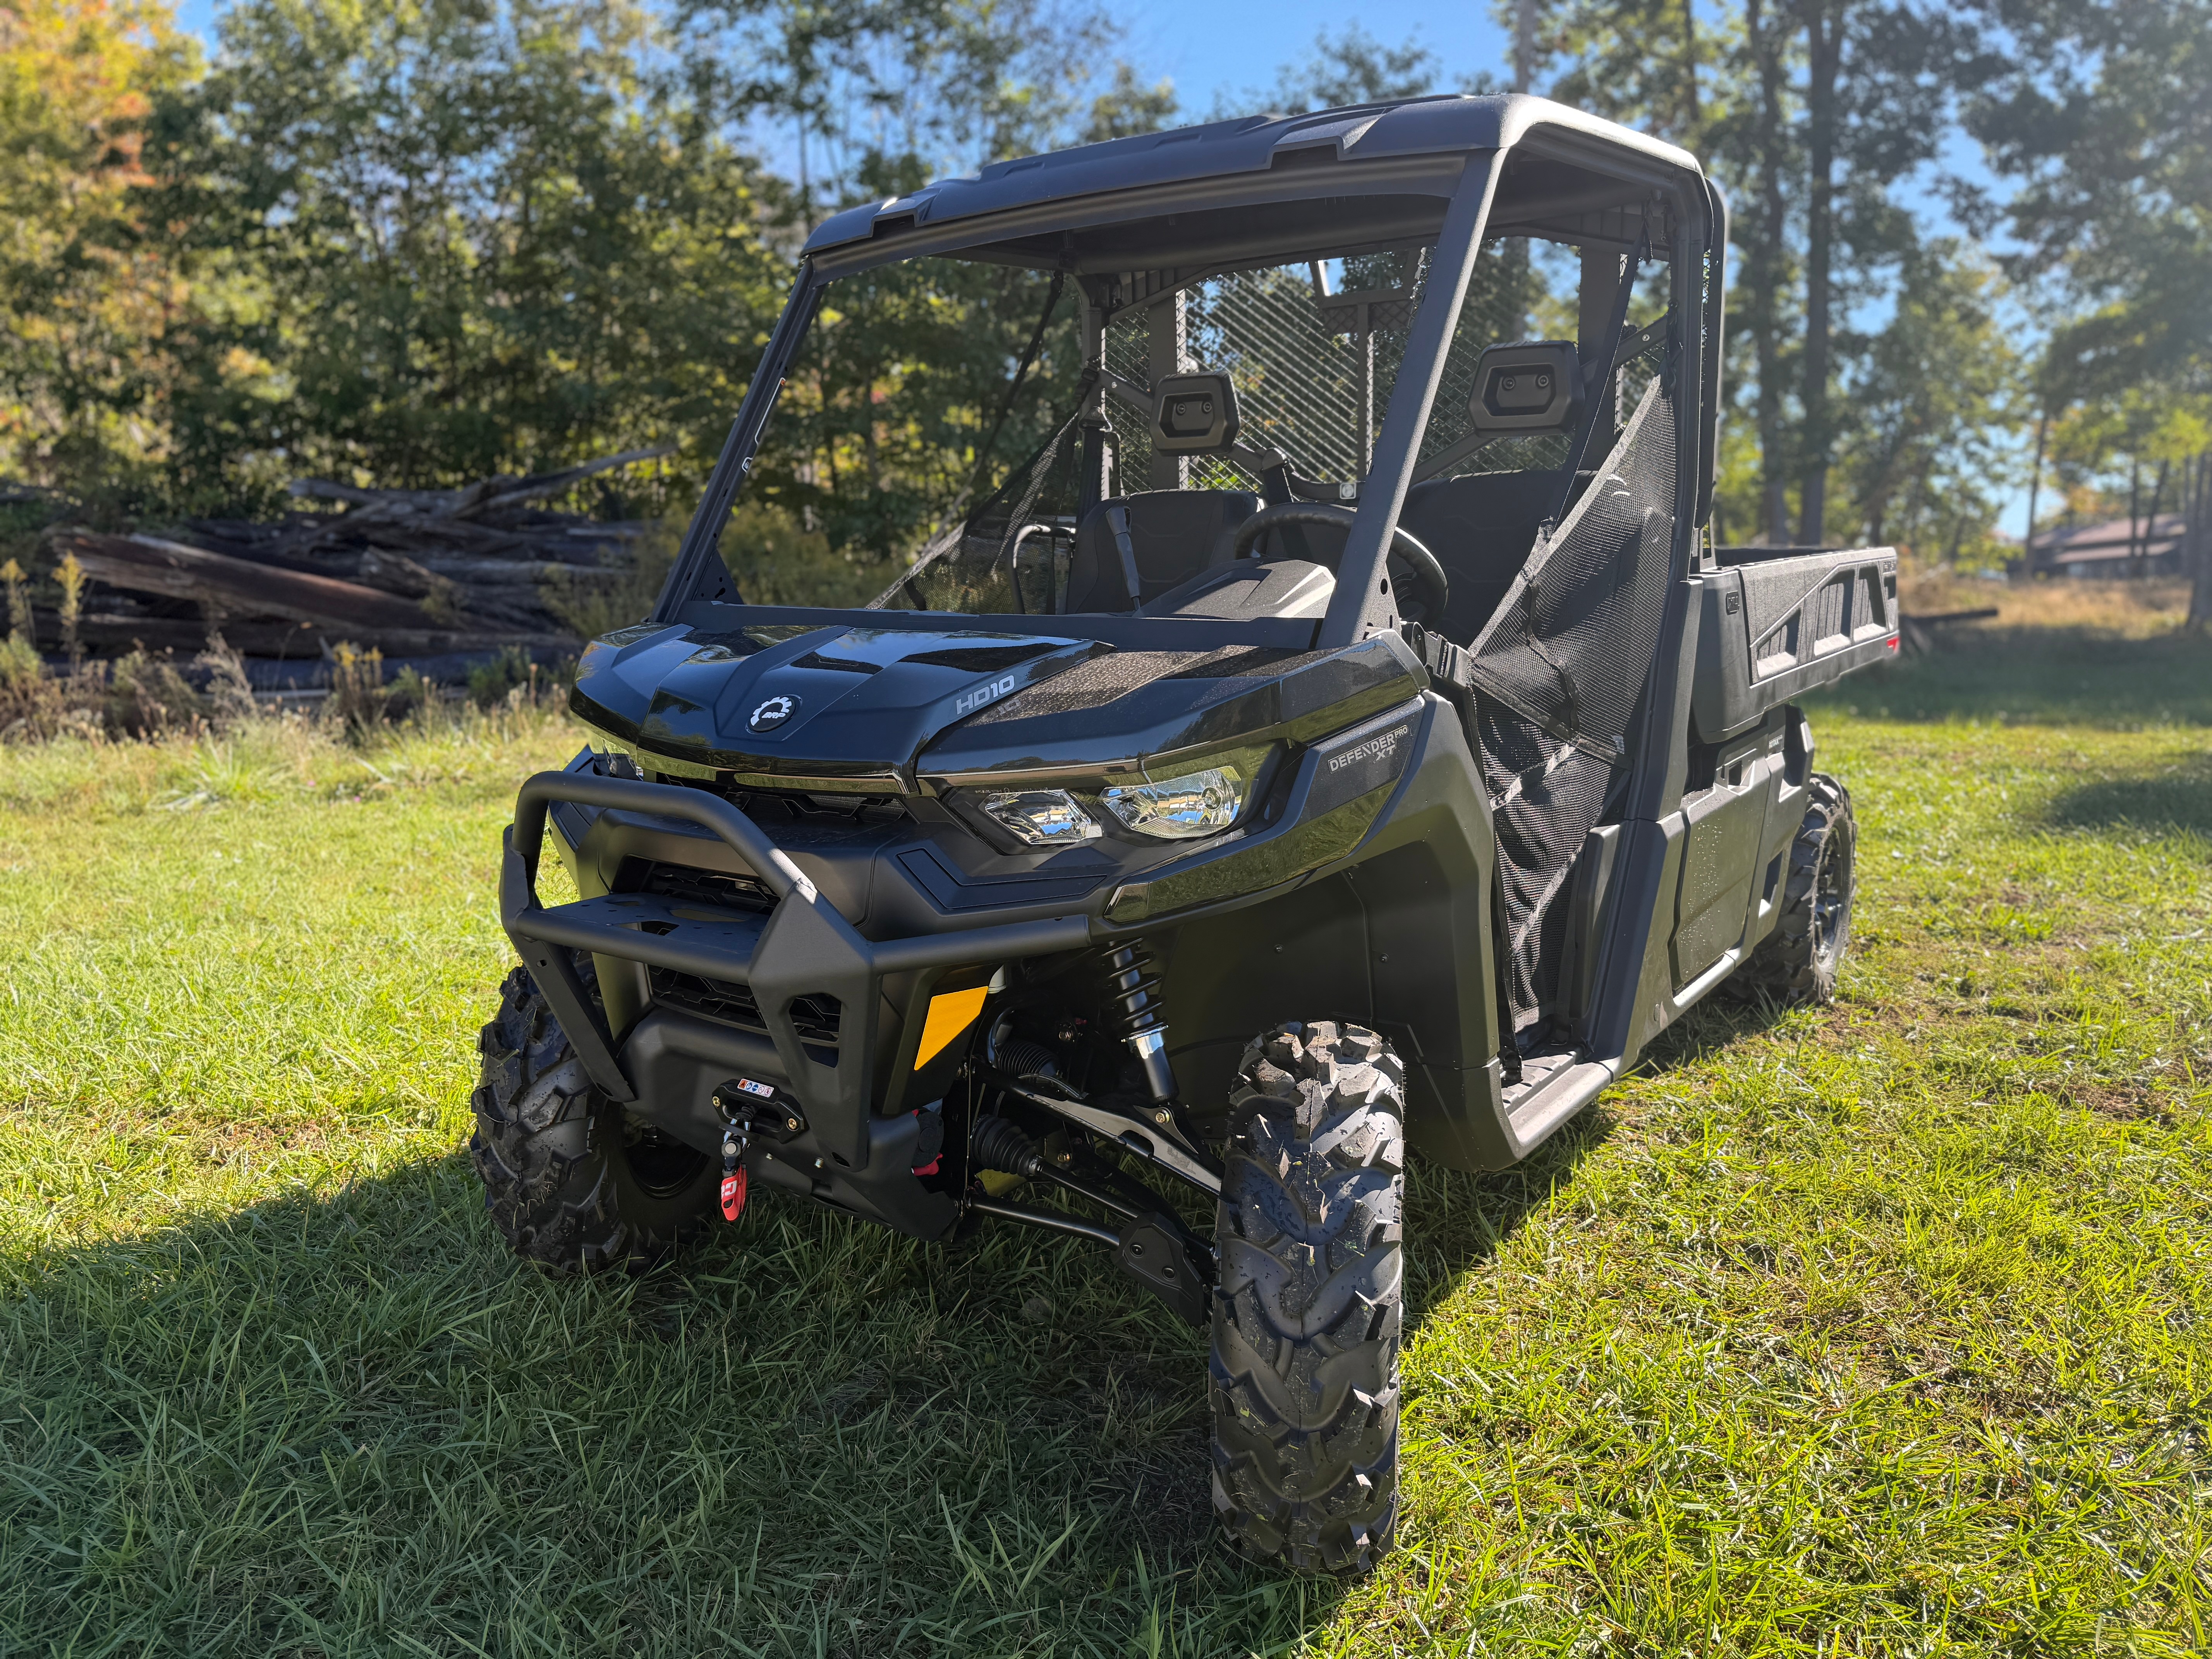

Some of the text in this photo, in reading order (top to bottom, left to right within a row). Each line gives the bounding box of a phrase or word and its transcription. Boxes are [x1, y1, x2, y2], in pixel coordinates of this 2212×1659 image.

[956, 675, 1015, 715] HD10
[1329, 726, 1408, 772] DEFENDER PRO
[1376, 744, 1395, 761] XT
